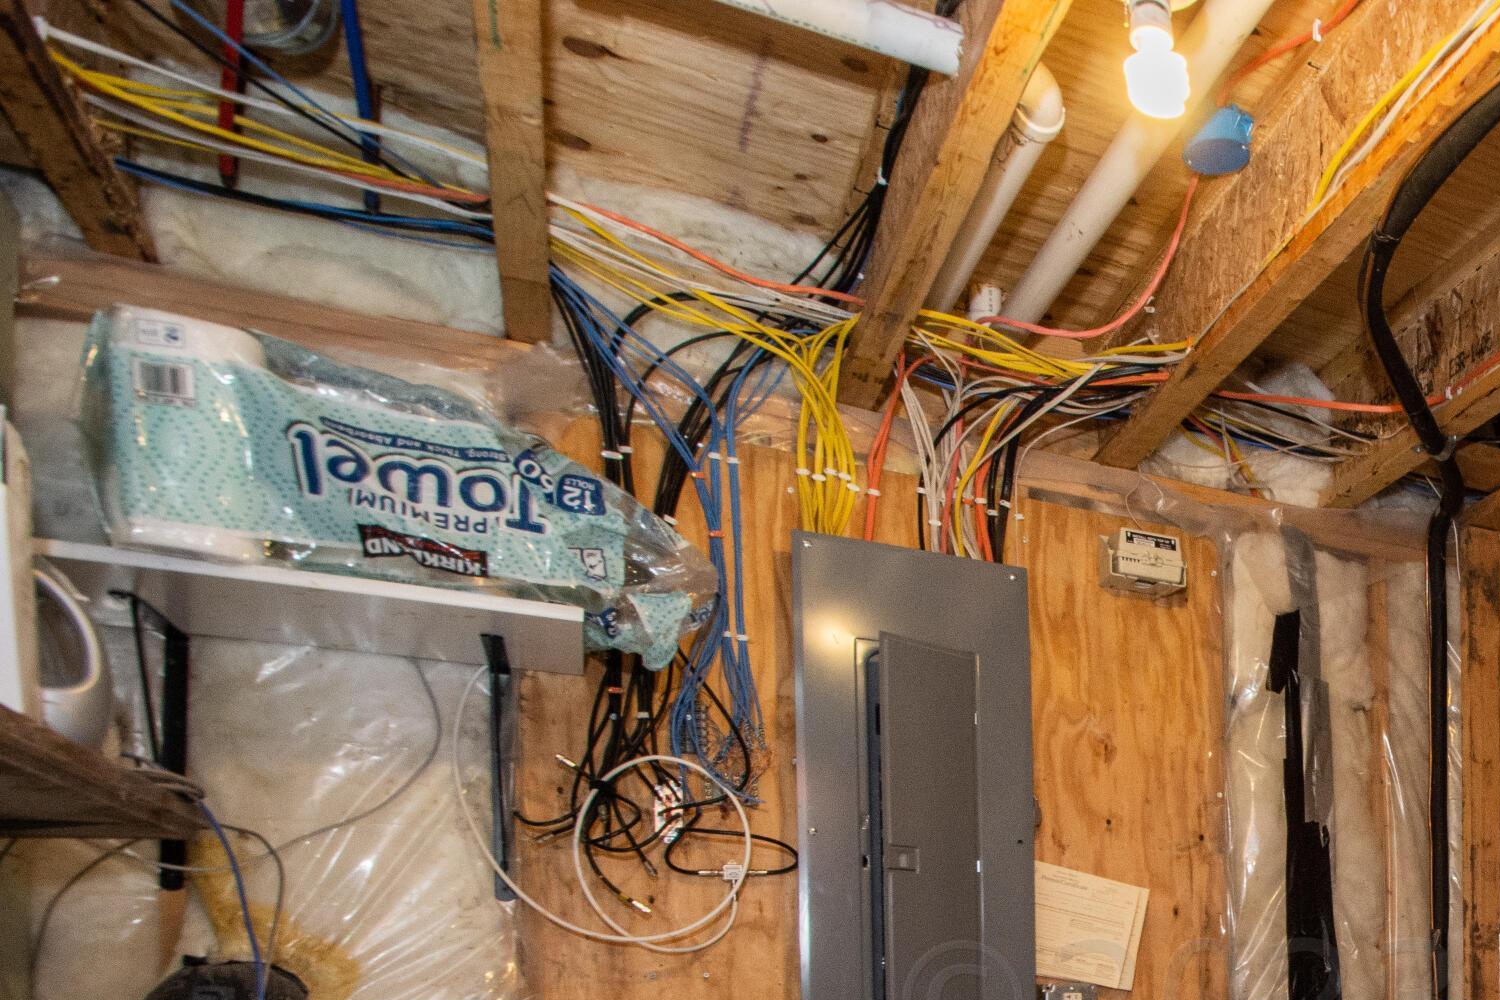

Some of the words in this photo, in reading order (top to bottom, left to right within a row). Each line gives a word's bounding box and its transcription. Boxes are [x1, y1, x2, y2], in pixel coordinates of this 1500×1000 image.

[397, 437, 421, 450] and
[427, 444, 460, 457] Thick
[288, 424, 548, 533] Towel
[562, 485, 596, 511] 12
[356, 489, 489, 535] PREMIUM
